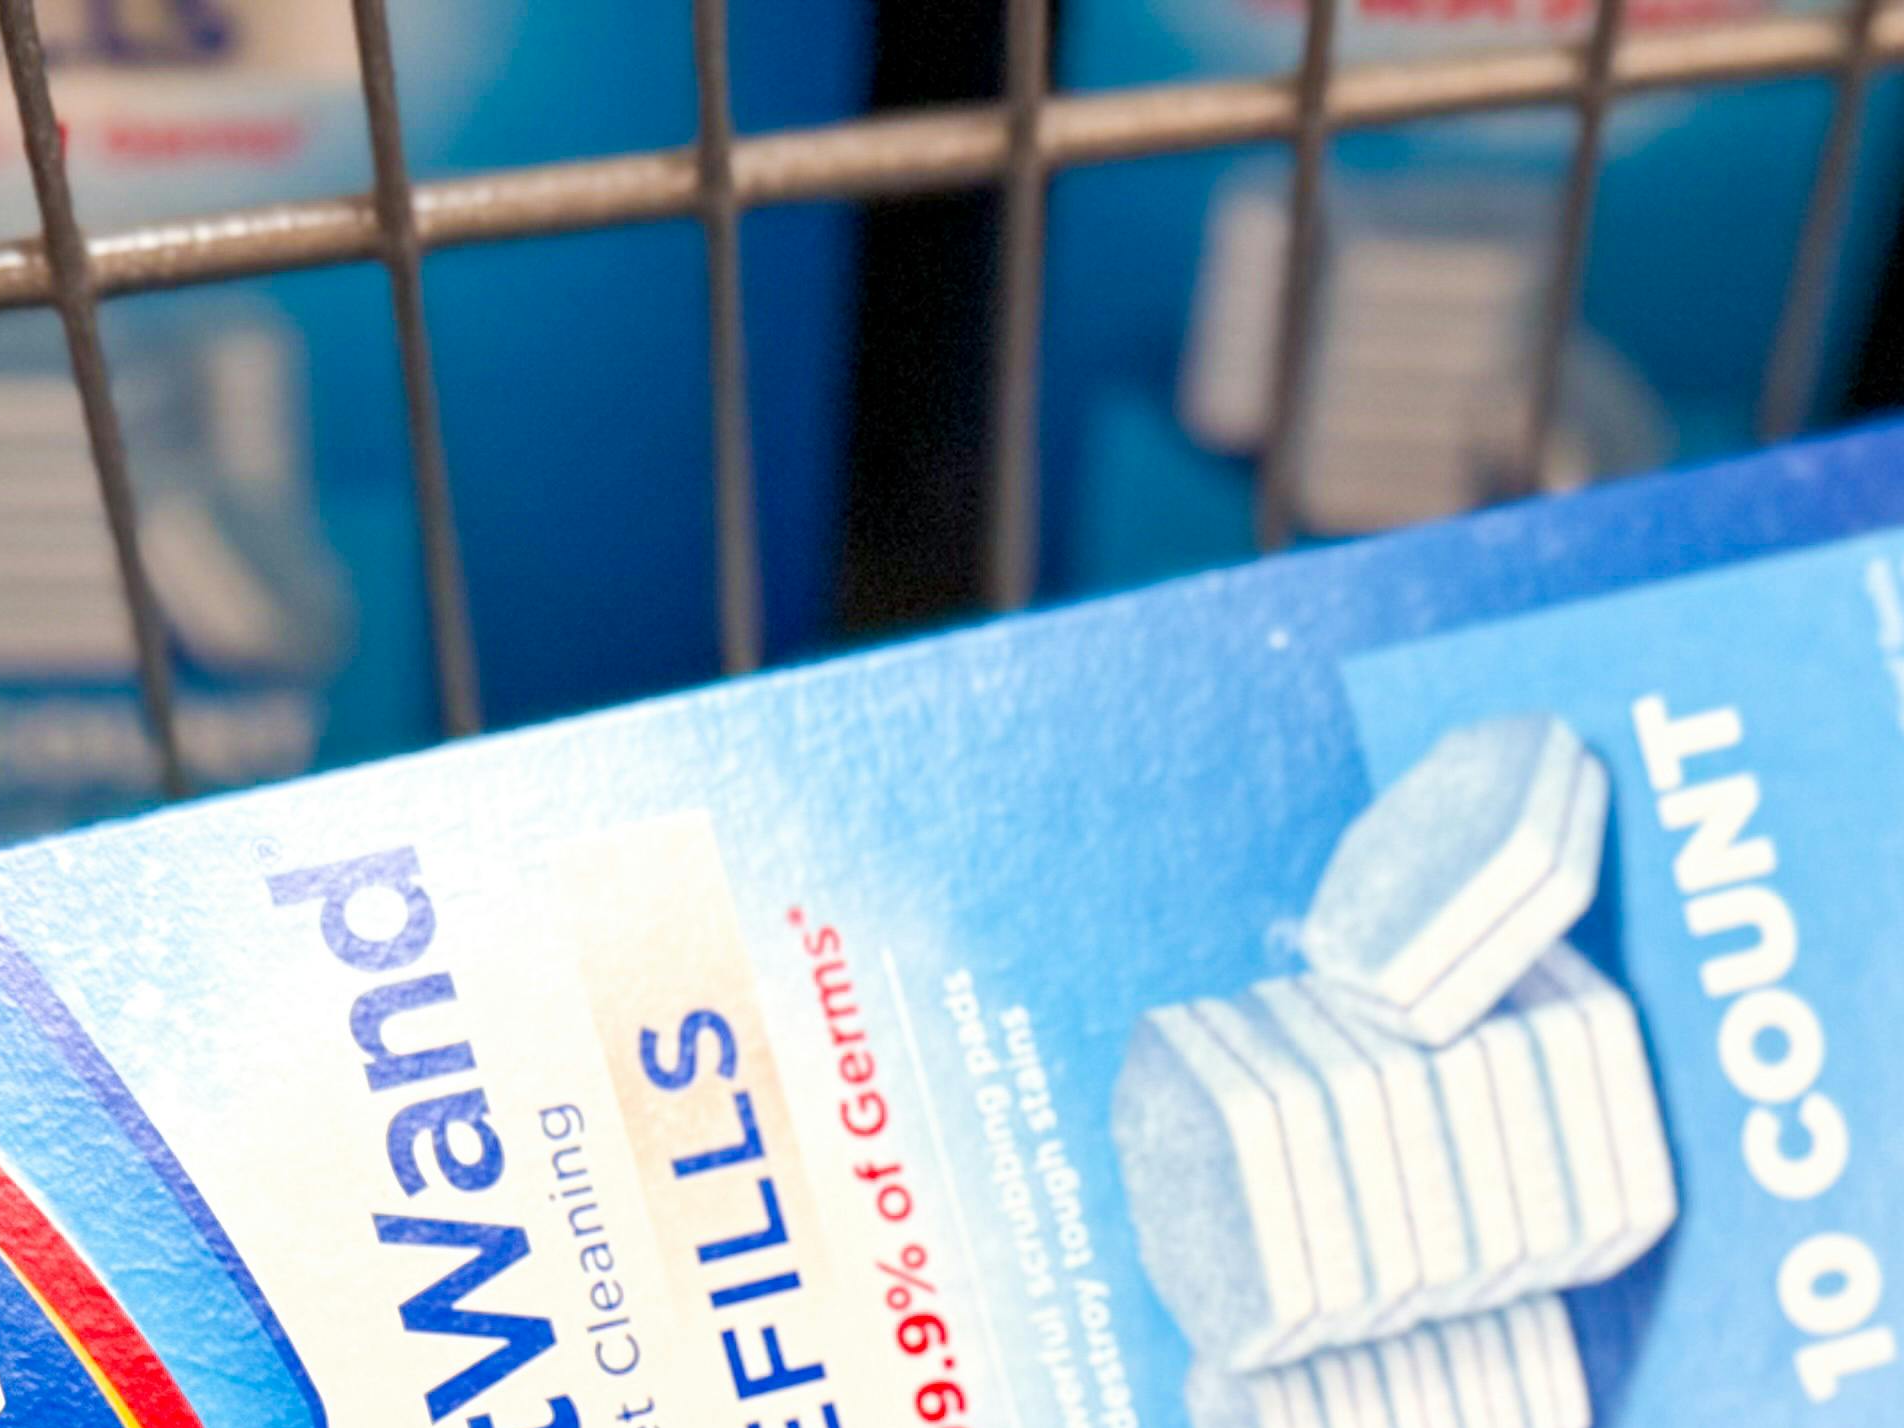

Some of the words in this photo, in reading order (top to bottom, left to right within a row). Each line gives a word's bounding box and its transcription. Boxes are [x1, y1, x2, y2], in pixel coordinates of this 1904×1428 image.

[1632, 694, 1850, 1200] COUNT
[943, 968, 1000, 1081] pads
[998, 1004, 1057, 1134] stains
[538, 1102, 641, 1376] Cleaning
[853, 1162, 913, 1222] of
[974, 1083, 1056, 1299] scrubbing
[1030, 1139, 1093, 1270] tough
[1778, 1232, 1897, 1402] 10
